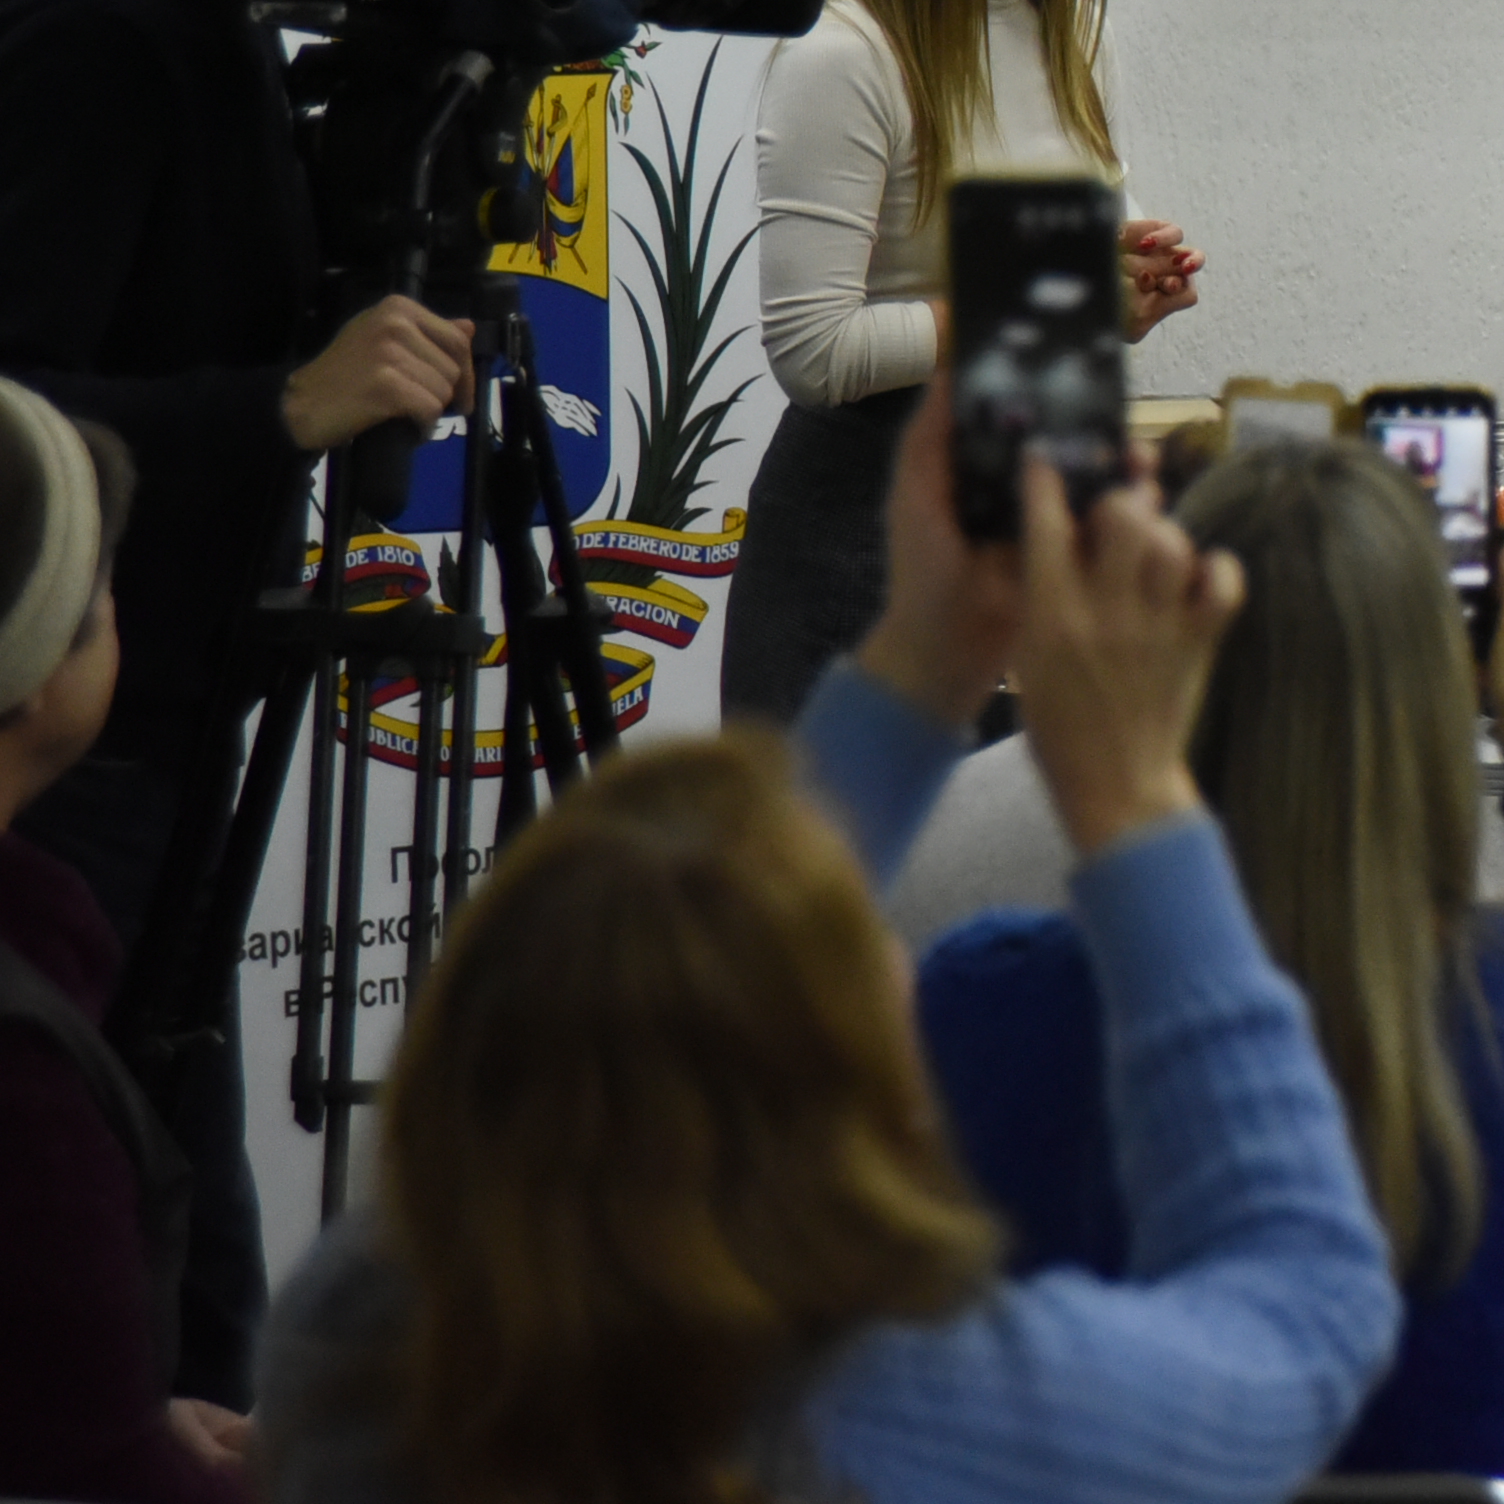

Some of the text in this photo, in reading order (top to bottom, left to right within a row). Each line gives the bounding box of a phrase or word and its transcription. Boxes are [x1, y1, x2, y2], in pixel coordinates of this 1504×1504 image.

[345, 545, 415, 569] DE 1810
[581, 531, 608, 549] DE
[608, 532, 682, 560] FEBRERO
[682, 543, 704, 563] DE
[705, 541, 741, 564] 1859
